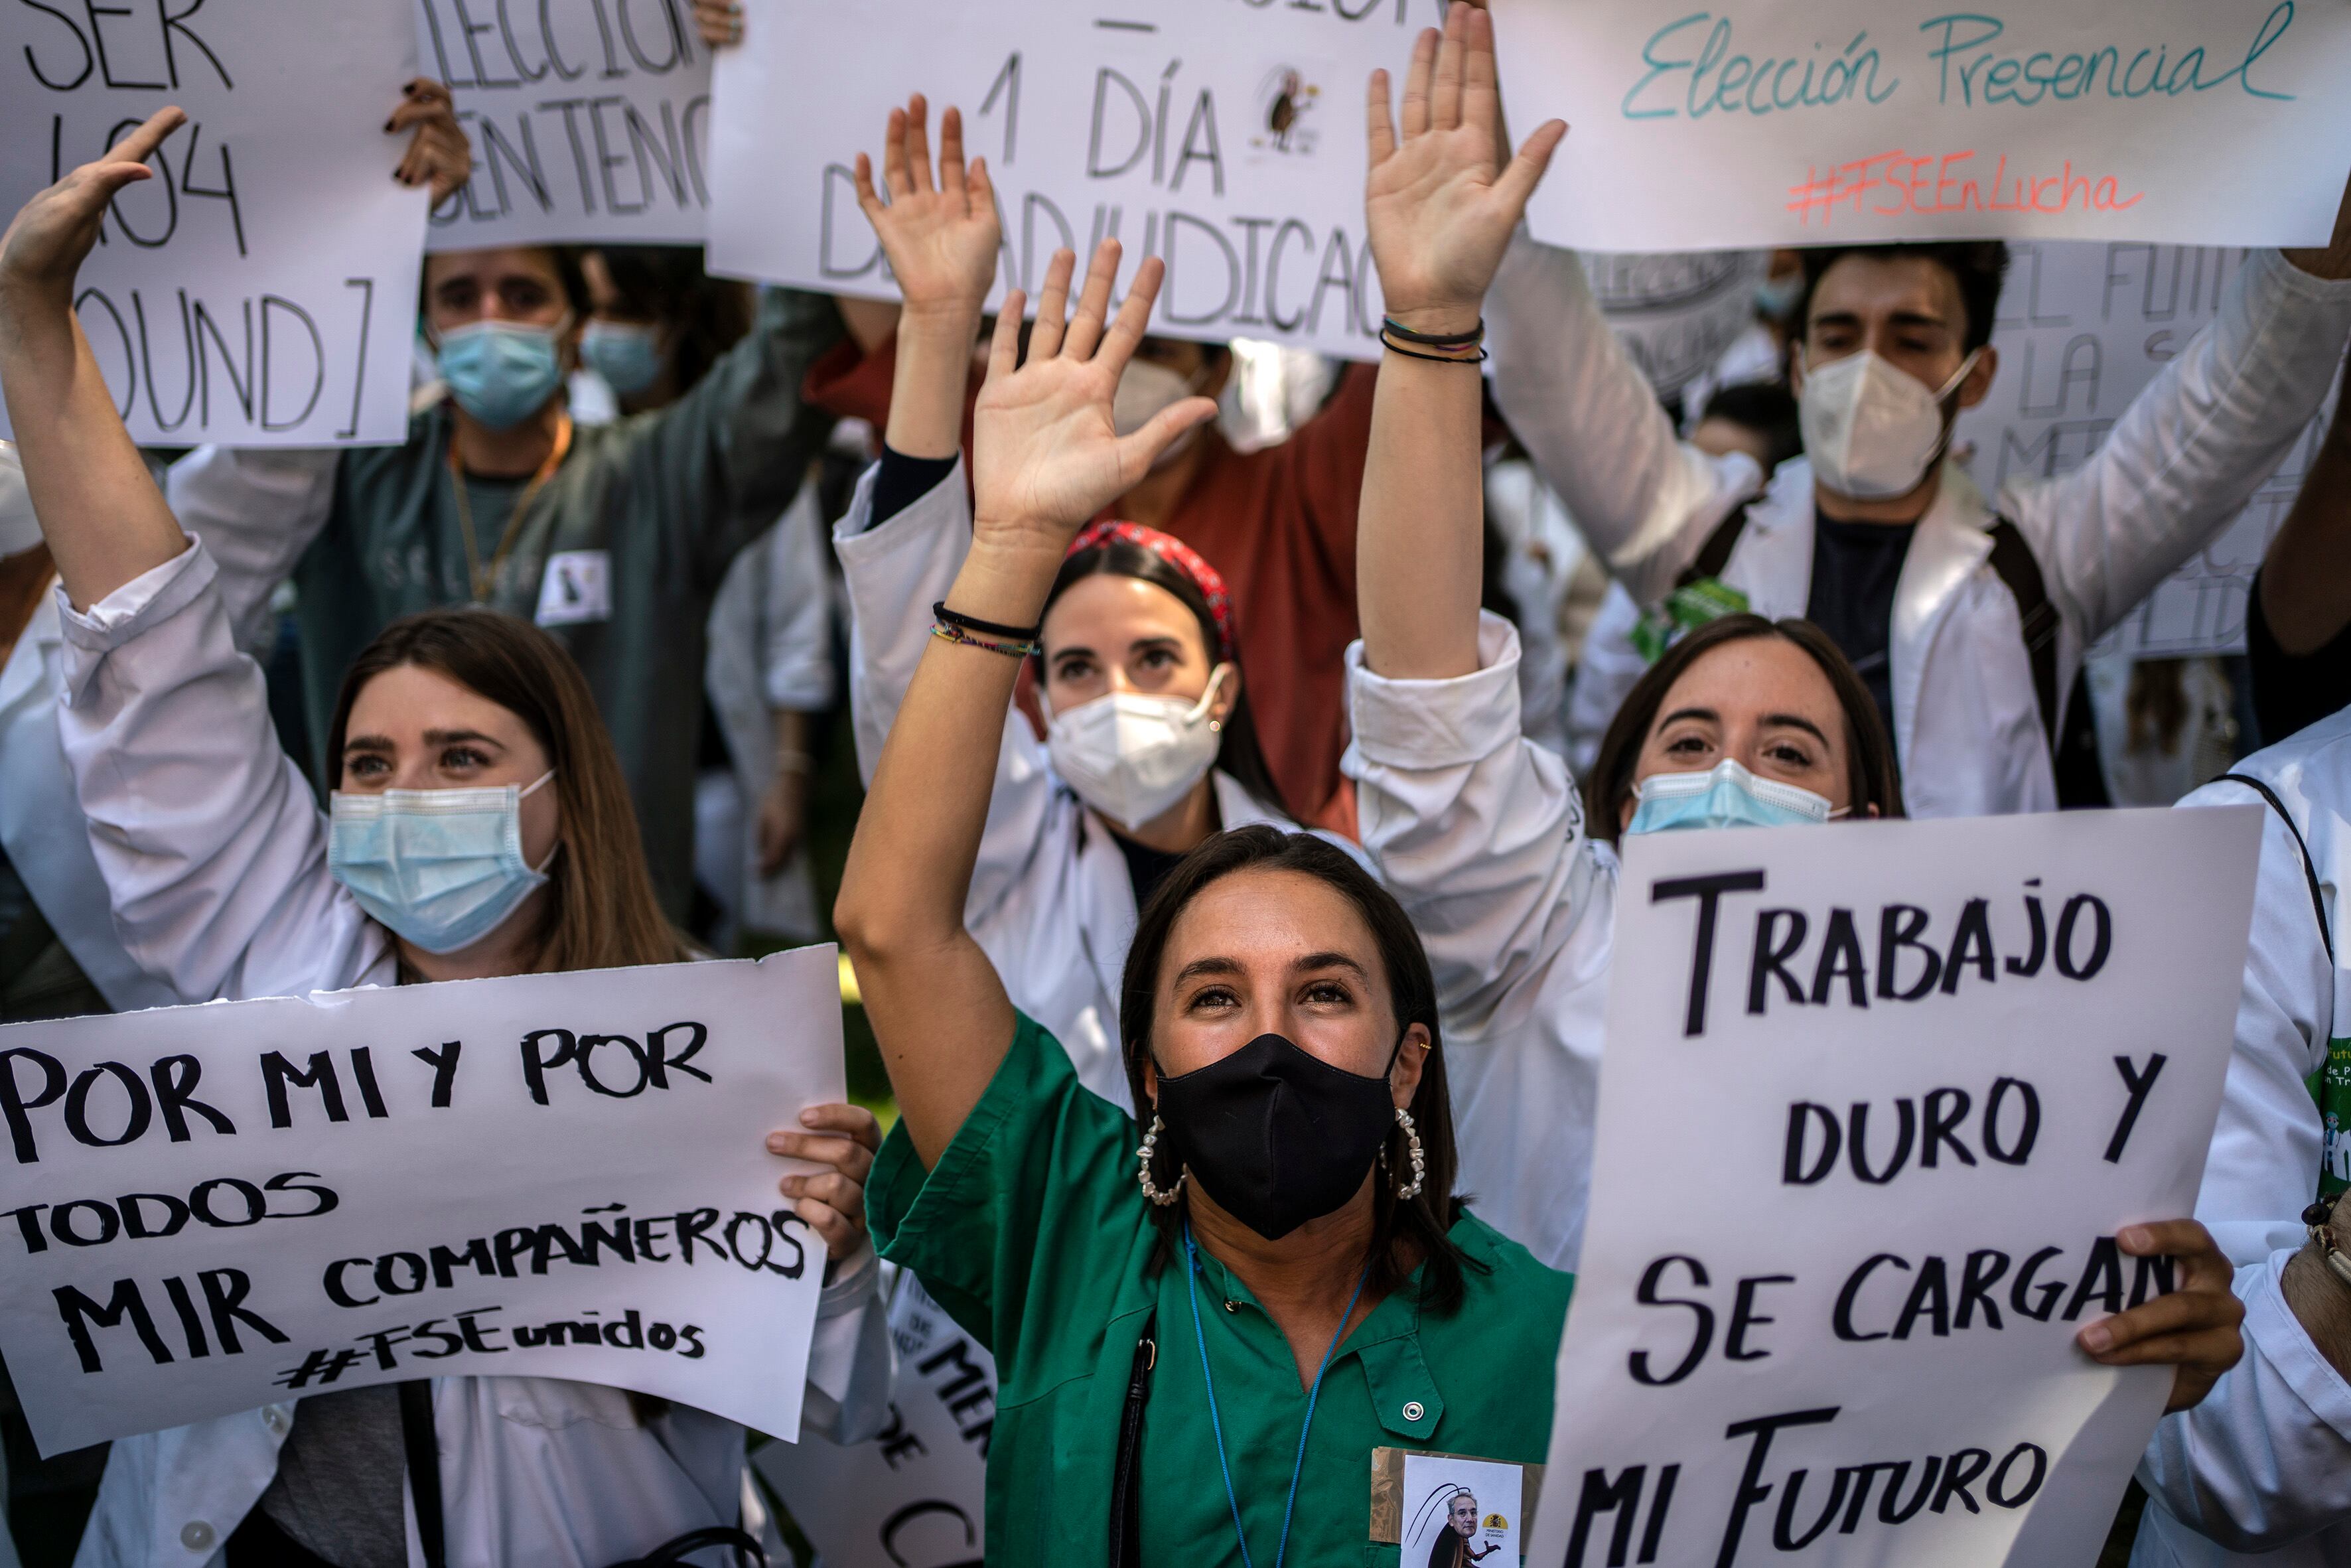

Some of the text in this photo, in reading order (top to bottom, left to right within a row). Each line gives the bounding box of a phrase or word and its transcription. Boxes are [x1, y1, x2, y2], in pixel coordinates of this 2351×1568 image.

[19, 0, 234, 91] SER
[1622, 0, 2298, 120] Elección Presencial
[977, 50, 1226, 197] 1 DÍA
[0, 1021, 713, 1164] POR MI Y POR
[1781, 1051, 2169, 1186] DURO Y
[0, 1172, 339, 1253] TODOS
[51, 1267, 291, 1374] MIR
[323, 1202, 810, 1307] COMPAÑEROS
[271, 1305, 706, 1390] #FSEunidos
[1628, 1235, 2176, 1387] SE CARGAN
[1563, 1462, 1682, 1568] MI
